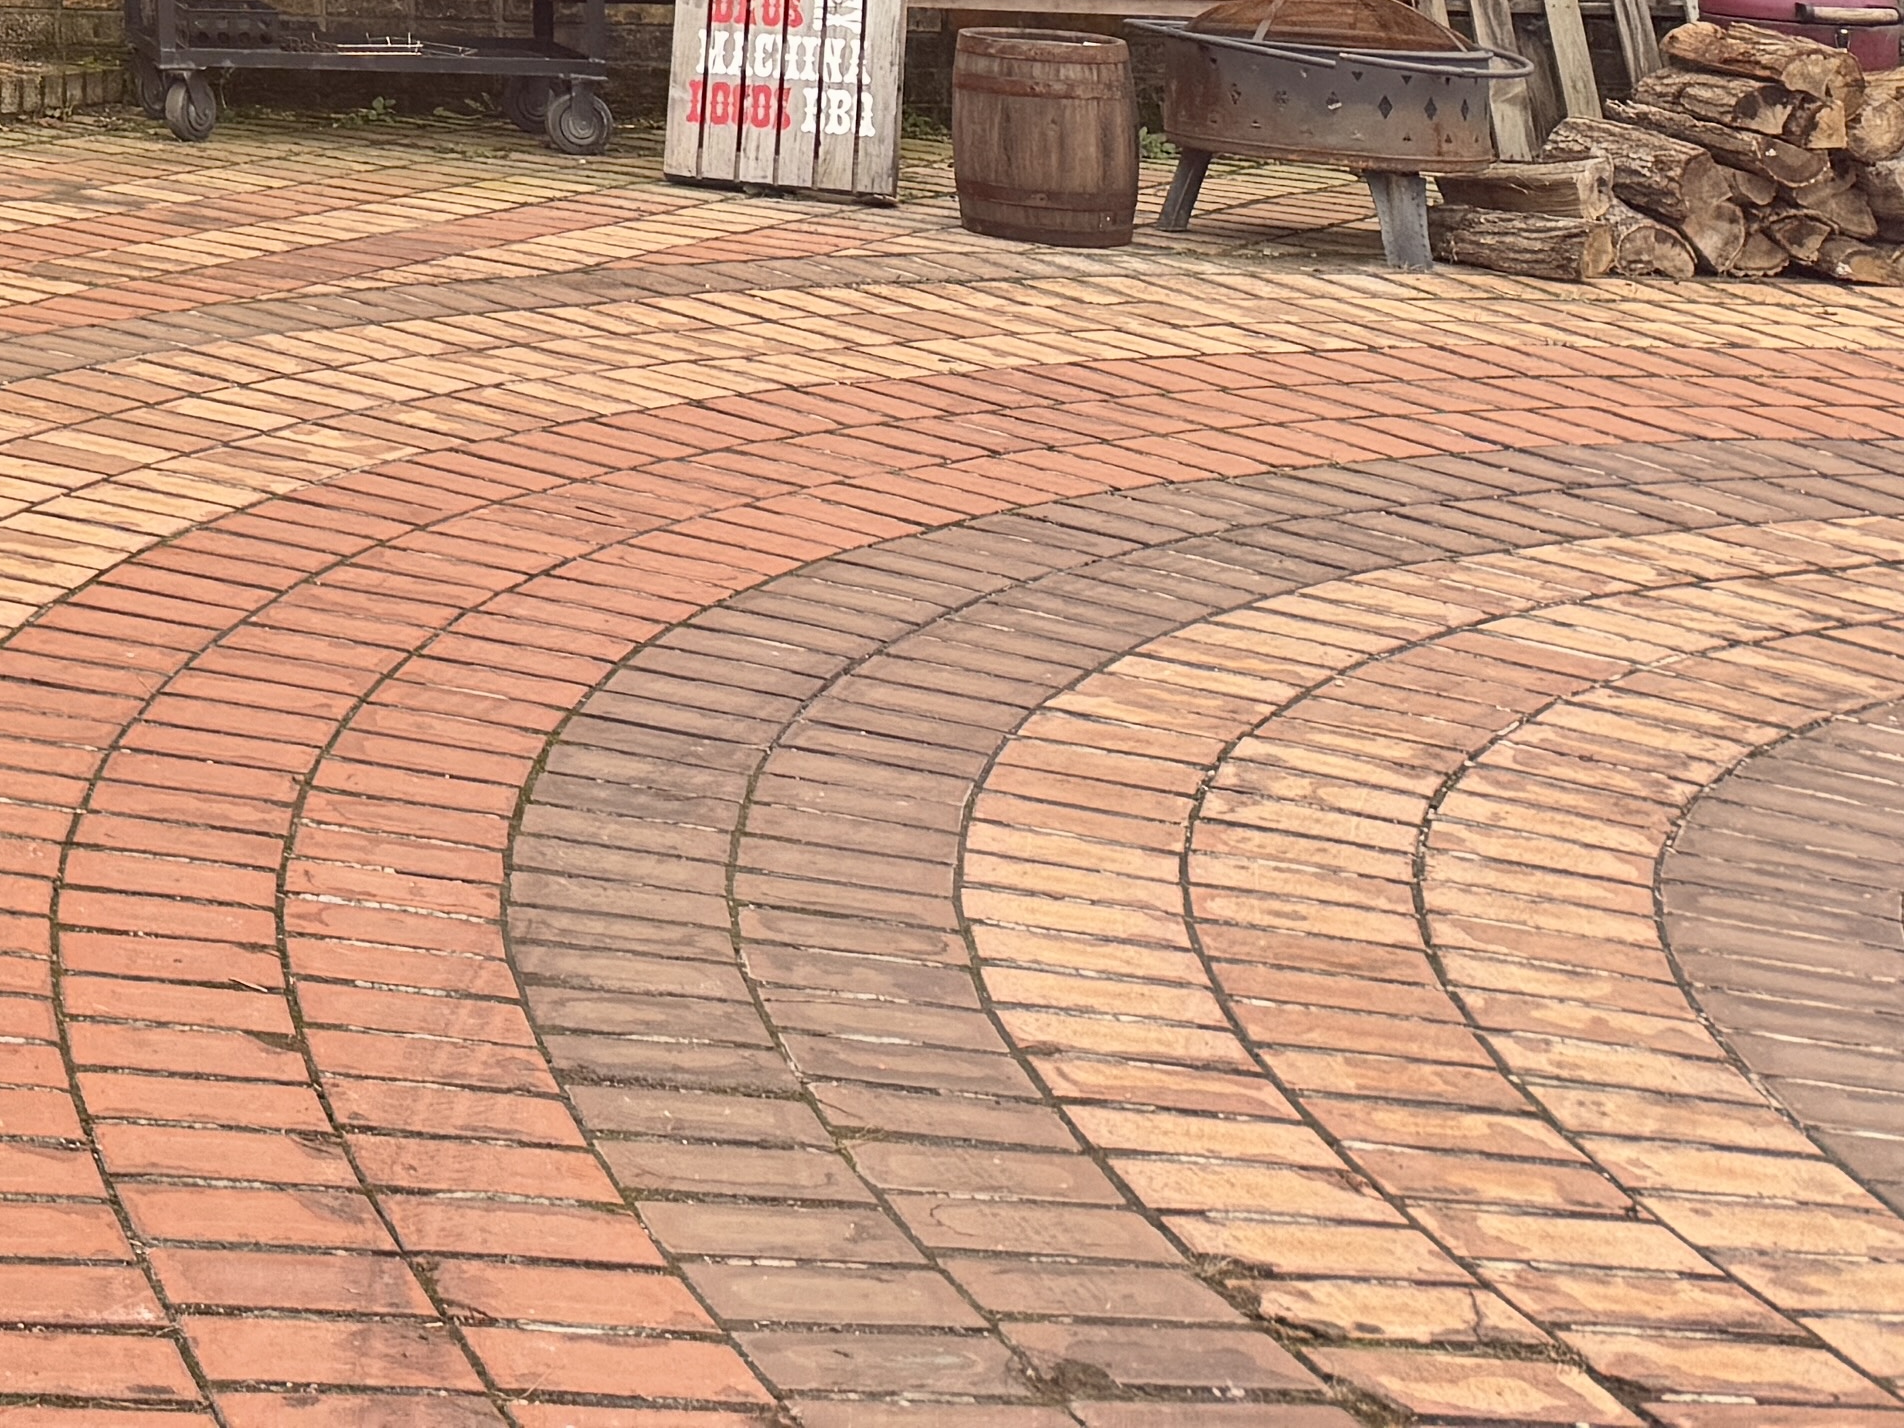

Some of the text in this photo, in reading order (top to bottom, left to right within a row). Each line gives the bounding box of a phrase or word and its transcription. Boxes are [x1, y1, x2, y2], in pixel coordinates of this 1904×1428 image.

[695, 29, 871, 84] MACHINA
[686, 80, 876, 137] LOCOS BBQ
